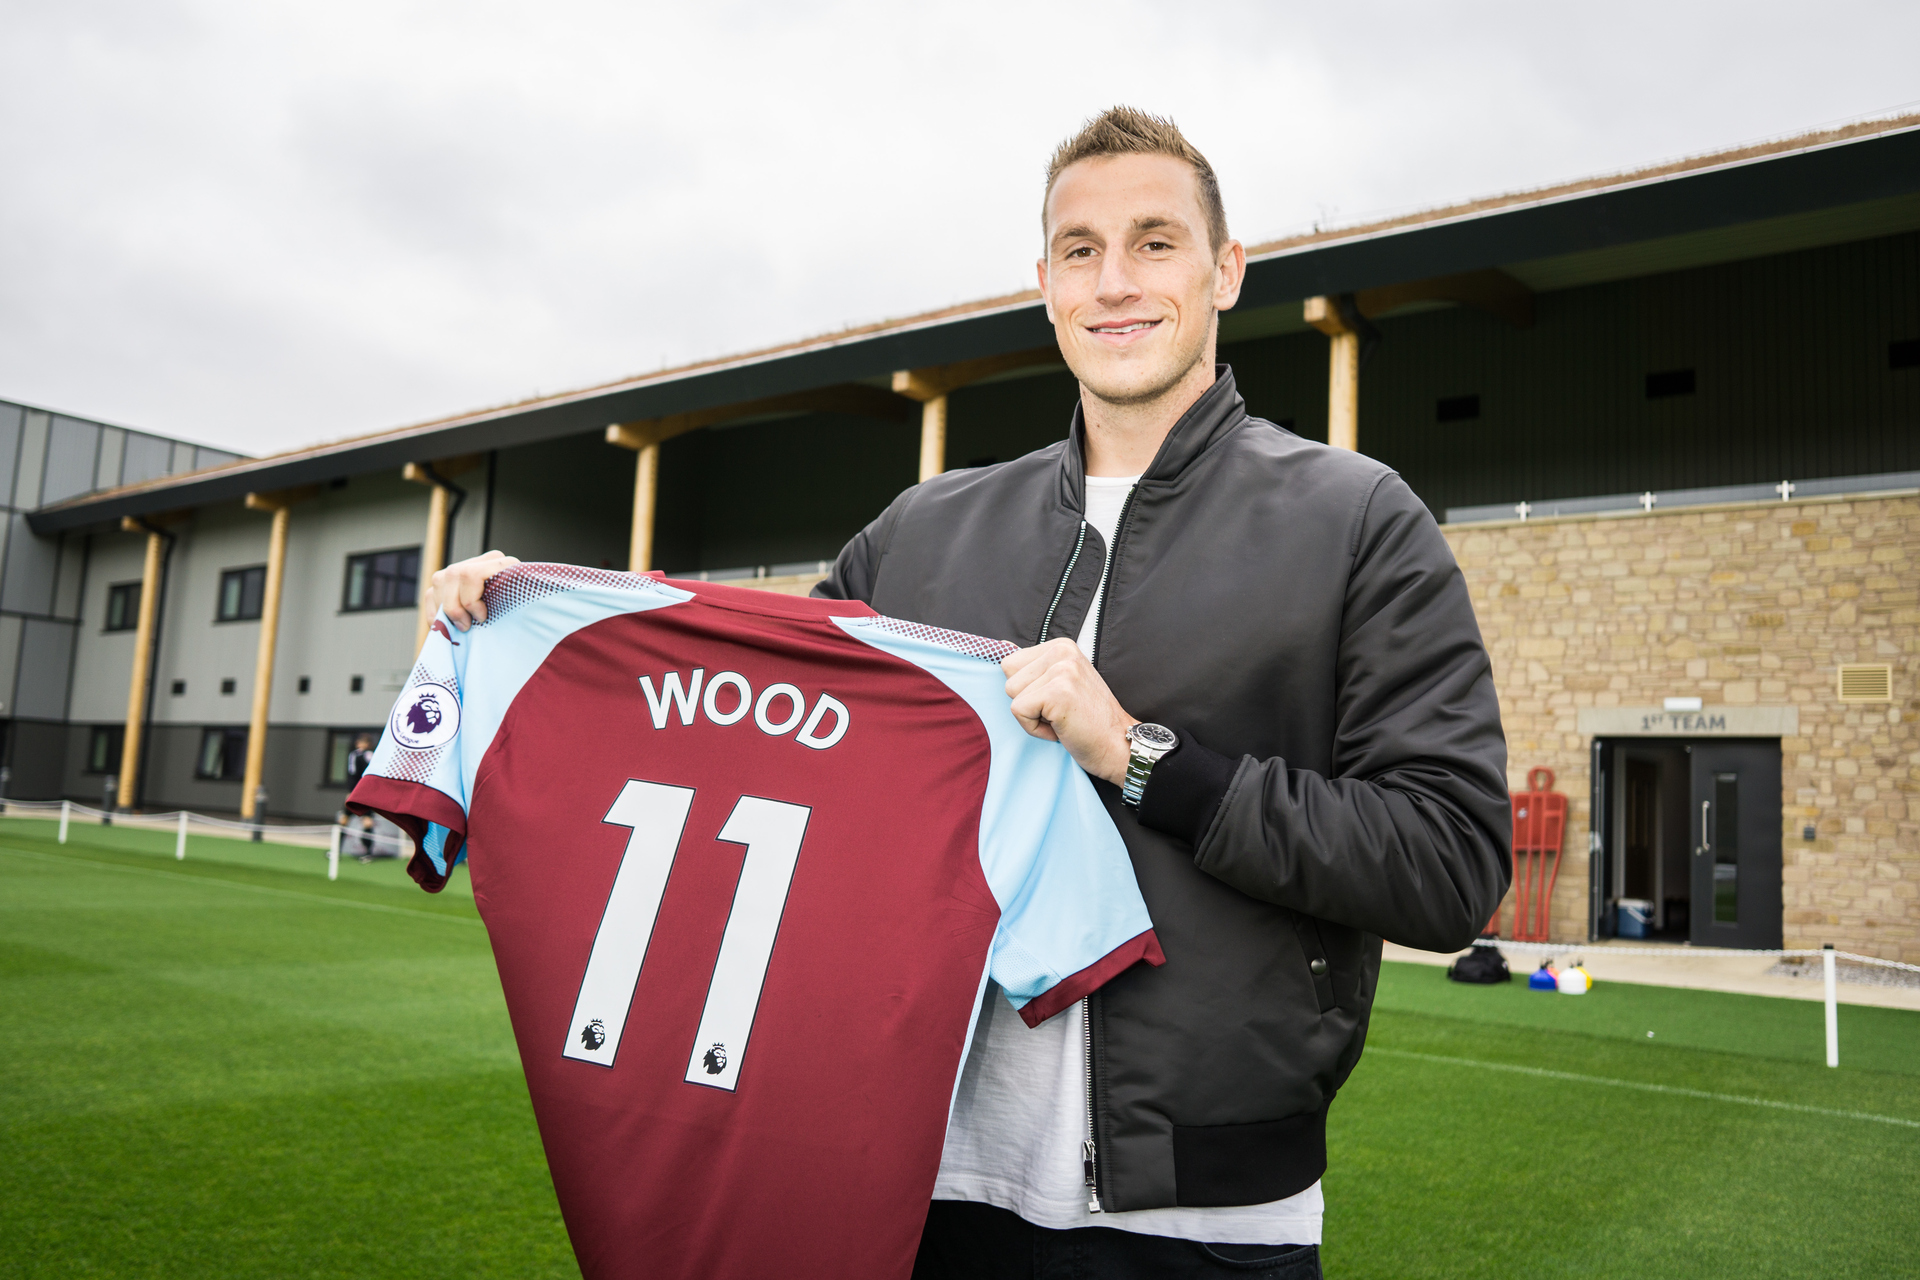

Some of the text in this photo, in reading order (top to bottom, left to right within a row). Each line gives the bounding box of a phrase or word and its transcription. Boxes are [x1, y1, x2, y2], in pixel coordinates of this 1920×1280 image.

[639, 668, 850, 750] WOOD
[1669, 714, 1726, 730] TEAM
[399, 732, 419, 743] League
[562, 778, 813, 1092] 11
